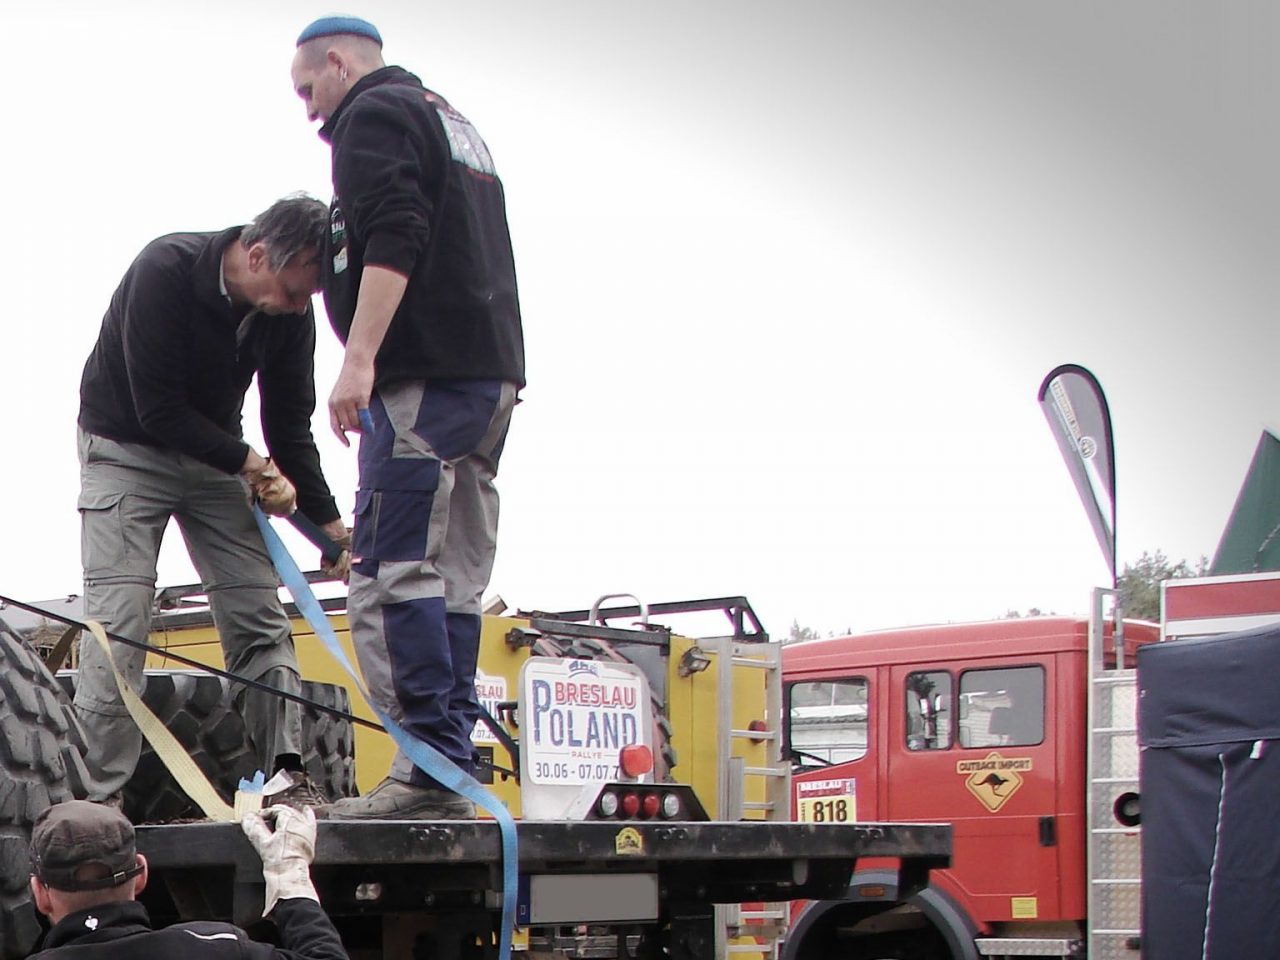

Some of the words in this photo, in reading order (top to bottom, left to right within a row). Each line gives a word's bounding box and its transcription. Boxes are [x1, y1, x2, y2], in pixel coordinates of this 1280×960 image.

[476, 685, 503, 698] SLAU
[555, 682, 637, 710] BRESLAU
[532, 680, 637, 749] POLAND
[571, 751, 602, 759] RALLYE
[536, 762, 568, 778] 30.06
[960, 761, 996, 771] OUTBACK
[998, 760, 1030, 770] IMPORT
[813, 800, 848, 822] 818
